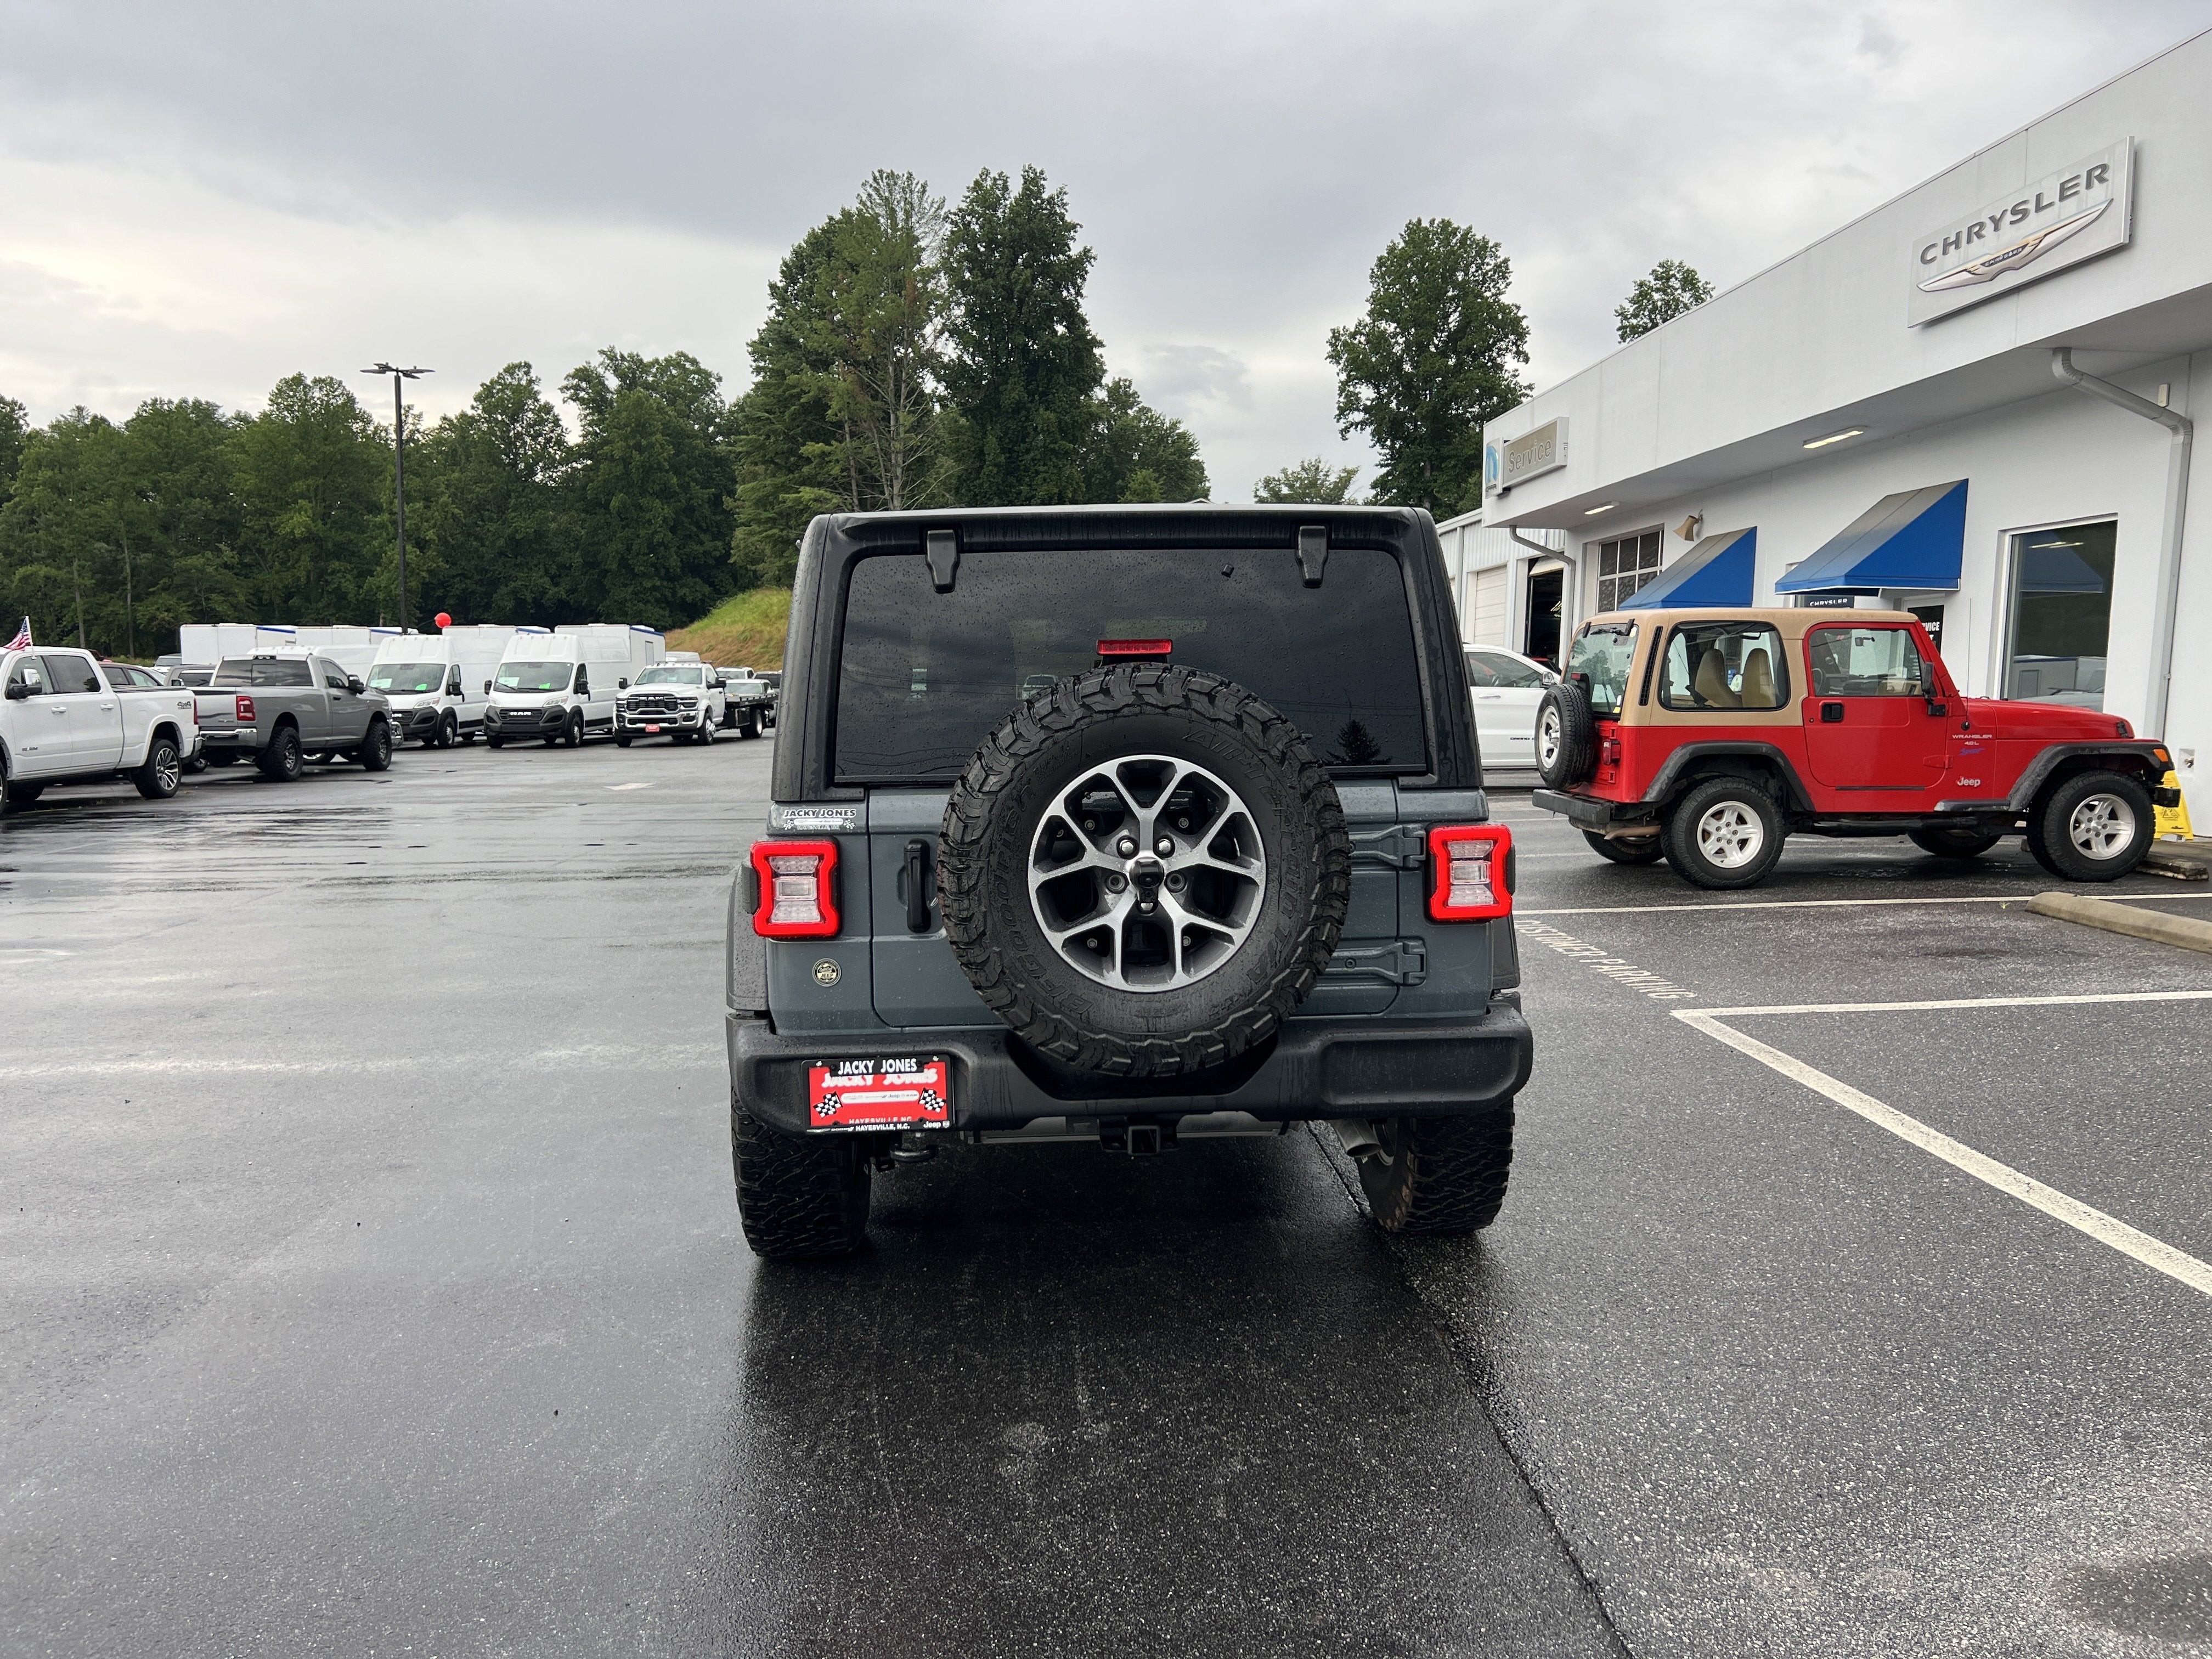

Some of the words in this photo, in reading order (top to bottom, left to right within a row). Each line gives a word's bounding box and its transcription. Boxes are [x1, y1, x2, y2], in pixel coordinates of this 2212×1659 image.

[1920, 163, 2109, 264] CHRYSLER
[1509, 439, 1552, 473] Service
[1809, 598, 1848, 606] CHRYSLER
[1957, 777, 1981, 787] Jeep
[783, 809, 819, 819] JACKY
[819, 809, 857, 818] JONES
[1514, 920, 1608, 957] CUSTOMER
[1579, 958, 1699, 999] PARKING
[838, 1060, 874, 1075] JACKY
[881, 1058, 917, 1073] JONES
